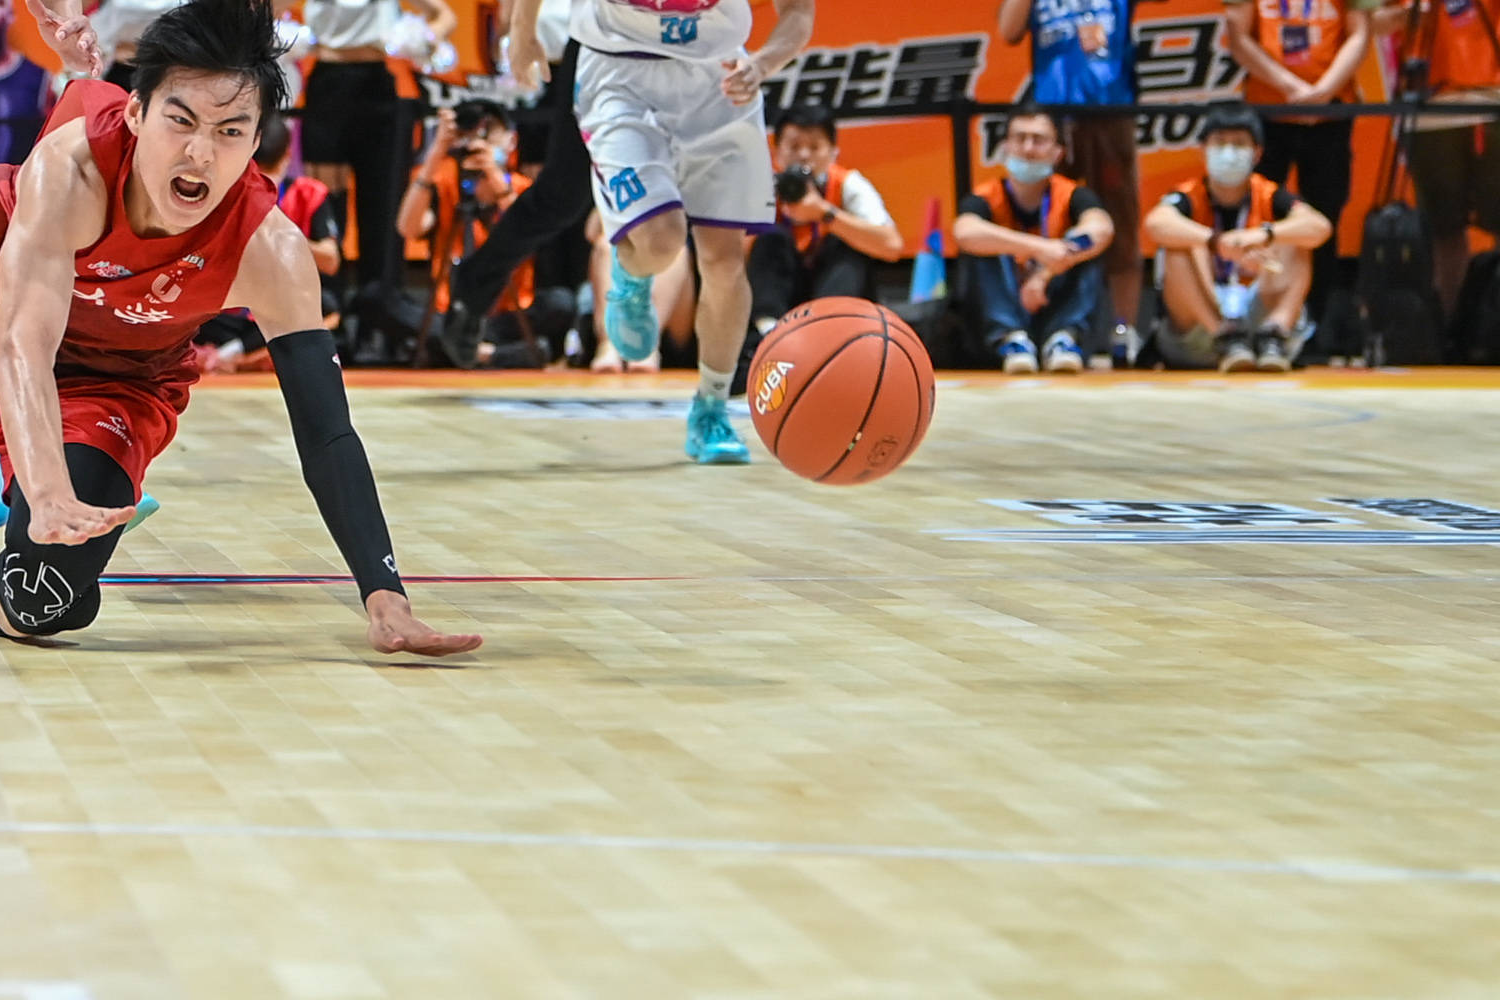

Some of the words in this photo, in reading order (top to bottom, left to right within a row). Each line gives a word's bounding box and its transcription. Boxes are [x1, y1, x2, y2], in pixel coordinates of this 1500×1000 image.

[660, 16, 699, 44] 20
[609, 167, 647, 212] 20
[755, 360, 796, 415] CUBA
